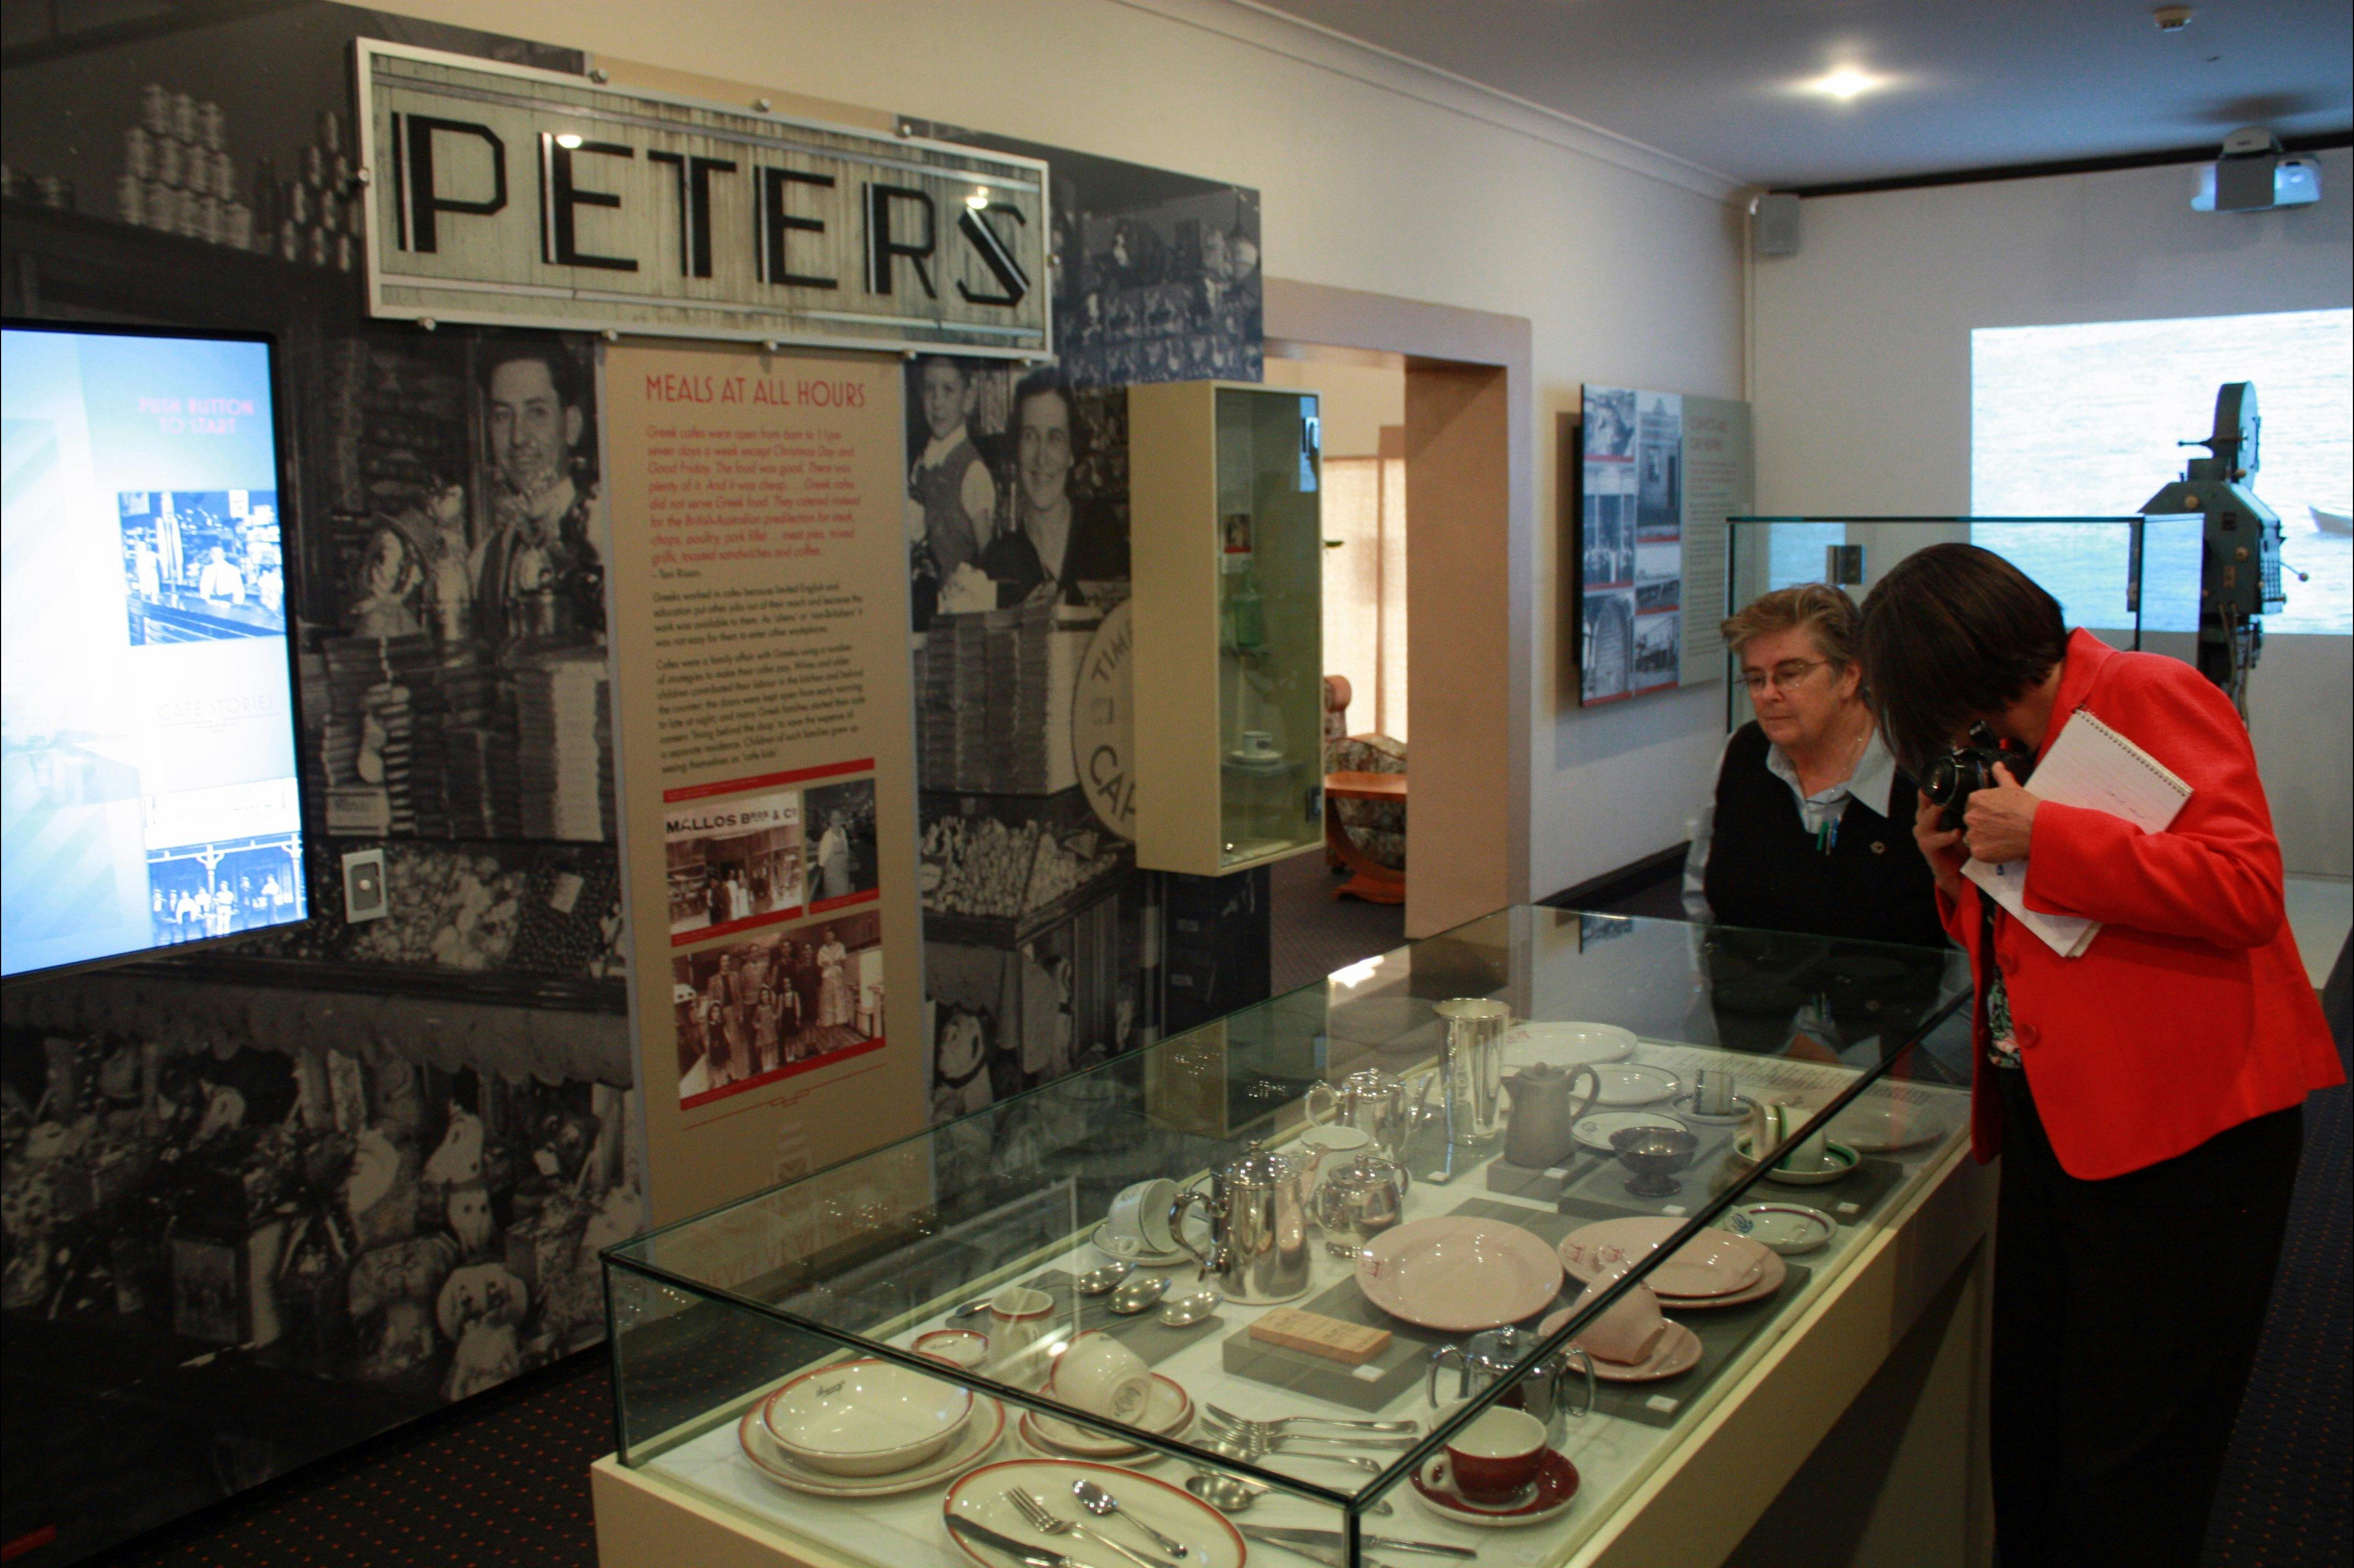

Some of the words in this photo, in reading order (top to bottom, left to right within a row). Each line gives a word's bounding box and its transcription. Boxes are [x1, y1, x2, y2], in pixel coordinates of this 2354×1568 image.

[392, 111, 1030, 307] PETERS
[645, 374, 713, 404] MEALS
[721, 378, 746, 404] AT
[753, 378, 791, 406] ALL
[798, 380, 865, 408] HOURS
[138, 397, 181, 415] PUSH
[188, 398, 254, 416] BUTTON
[159, 418, 184, 435] TO
[190, 418, 236, 435] START
[157, 701, 201, 721] CAFE
[210, 693, 275, 715] STORIES
[666, 814, 737, 834] MALLOS
